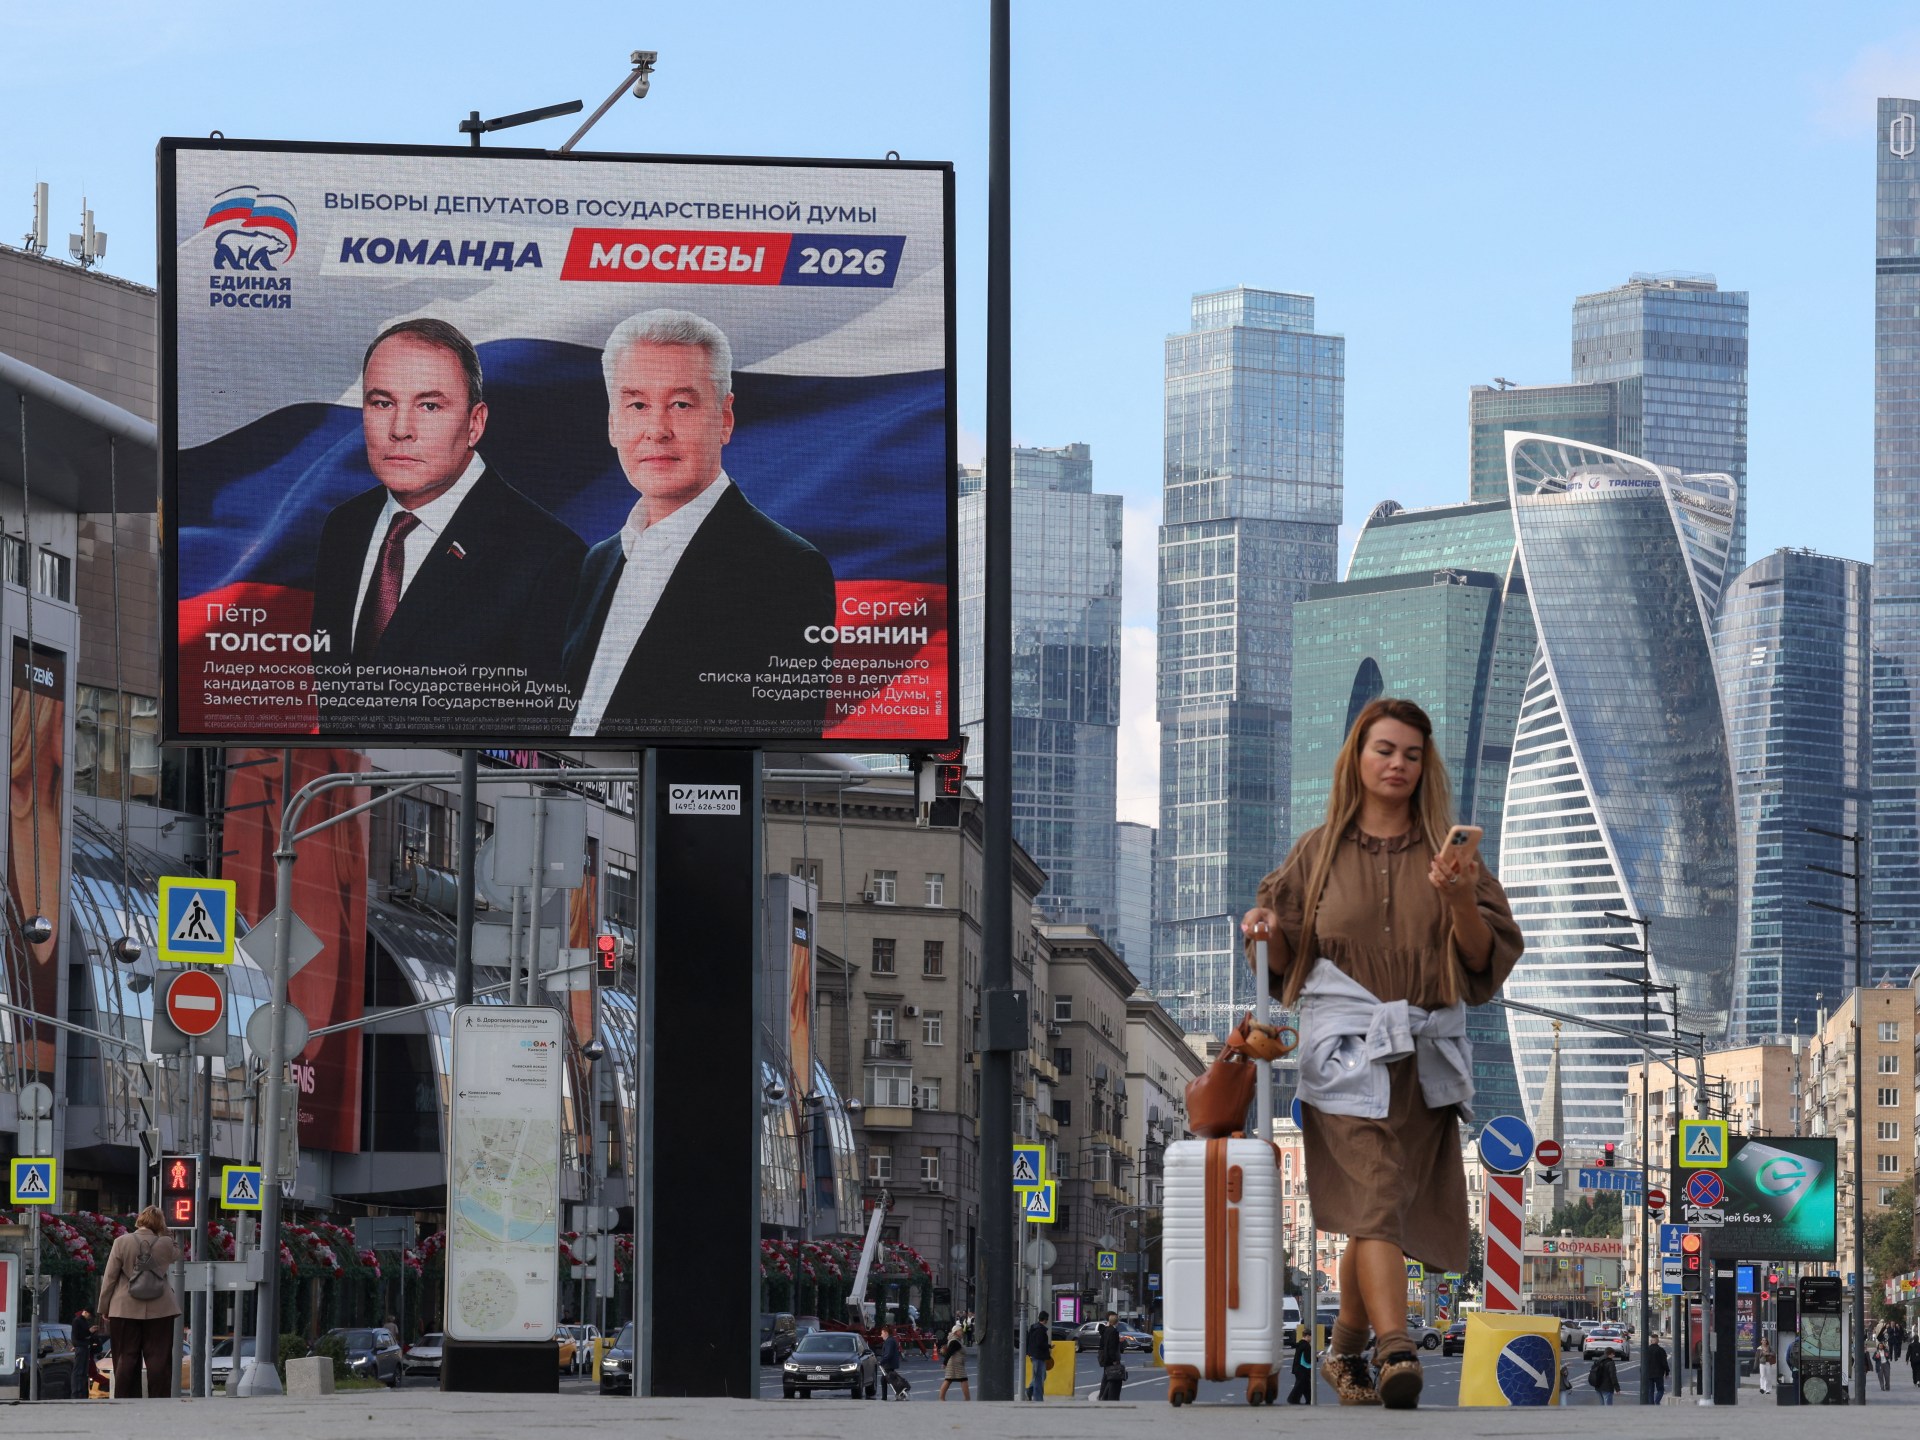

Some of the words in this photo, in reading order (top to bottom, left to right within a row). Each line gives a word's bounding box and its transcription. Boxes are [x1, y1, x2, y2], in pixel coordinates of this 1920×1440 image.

[325, 191, 428, 213] ВЫБОРЫ
[434, 194, 569, 216] ДЕПУТАТОВ
[576, 198, 801, 222] ГОСУДАРСТВЕННОЙ
[807, 205, 877, 225] ДУМЫ
[340, 236, 543, 272] КОМАНДА
[588, 242, 766, 273] МОСКВЫ
[798, 247, 888, 276] 2026
[210, 275, 292, 292] ЕДИНАЯ
[210, 293, 292, 309] РОССИЯ
[206, 603, 267, 626] Пётр
[842, 596, 927, 621] Сергей
[205, 629, 331, 653] ТОЛСТОЙ
[803, 625, 927, 645] СОБЯНИН
[203, 661, 255, 677] Лидер
[259, 662, 352, 676] московской
[356, 663, 468, 679] региональной
[472, 666, 529, 680] группы
[768, 656, 818, 672] Лидер
[821, 656, 930, 671] федерального
[24, 663, 54, 688] TZENIS
[698, 673, 752, 685] списка
[755, 672, 843, 686] кандидатов
[847, 674, 856, 684] в
[860, 674, 930, 687] депутаты
[203, 679, 295, 692] кандидатов
[299, 681, 308, 691] в
[311, 681, 384, 694] депутаты
[388, 679, 521, 695] Государственной
[525, 680, 572, 696] Думы,
[752, 687, 881, 702] Государственной
[884, 688, 930, 703] Думы,
[203, 693, 303, 707] Заместитель
[307, 694, 418, 709] Председателя
[422, 694, 554, 711] Государственной
[835, 703, 866, 717] Мэр
[870, 703, 930, 716] Москвы
[935, 690, 943, 716] mos.ru
[697, 803, 736, 811] 626-5200
[1724, 1213, 1741, 1223] ней
[1743, 1213, 1761, 1223] без
[1558, 1241, 1625, 1254] ФОРАБАНК
[1688, 1256, 1699, 1270] 12
